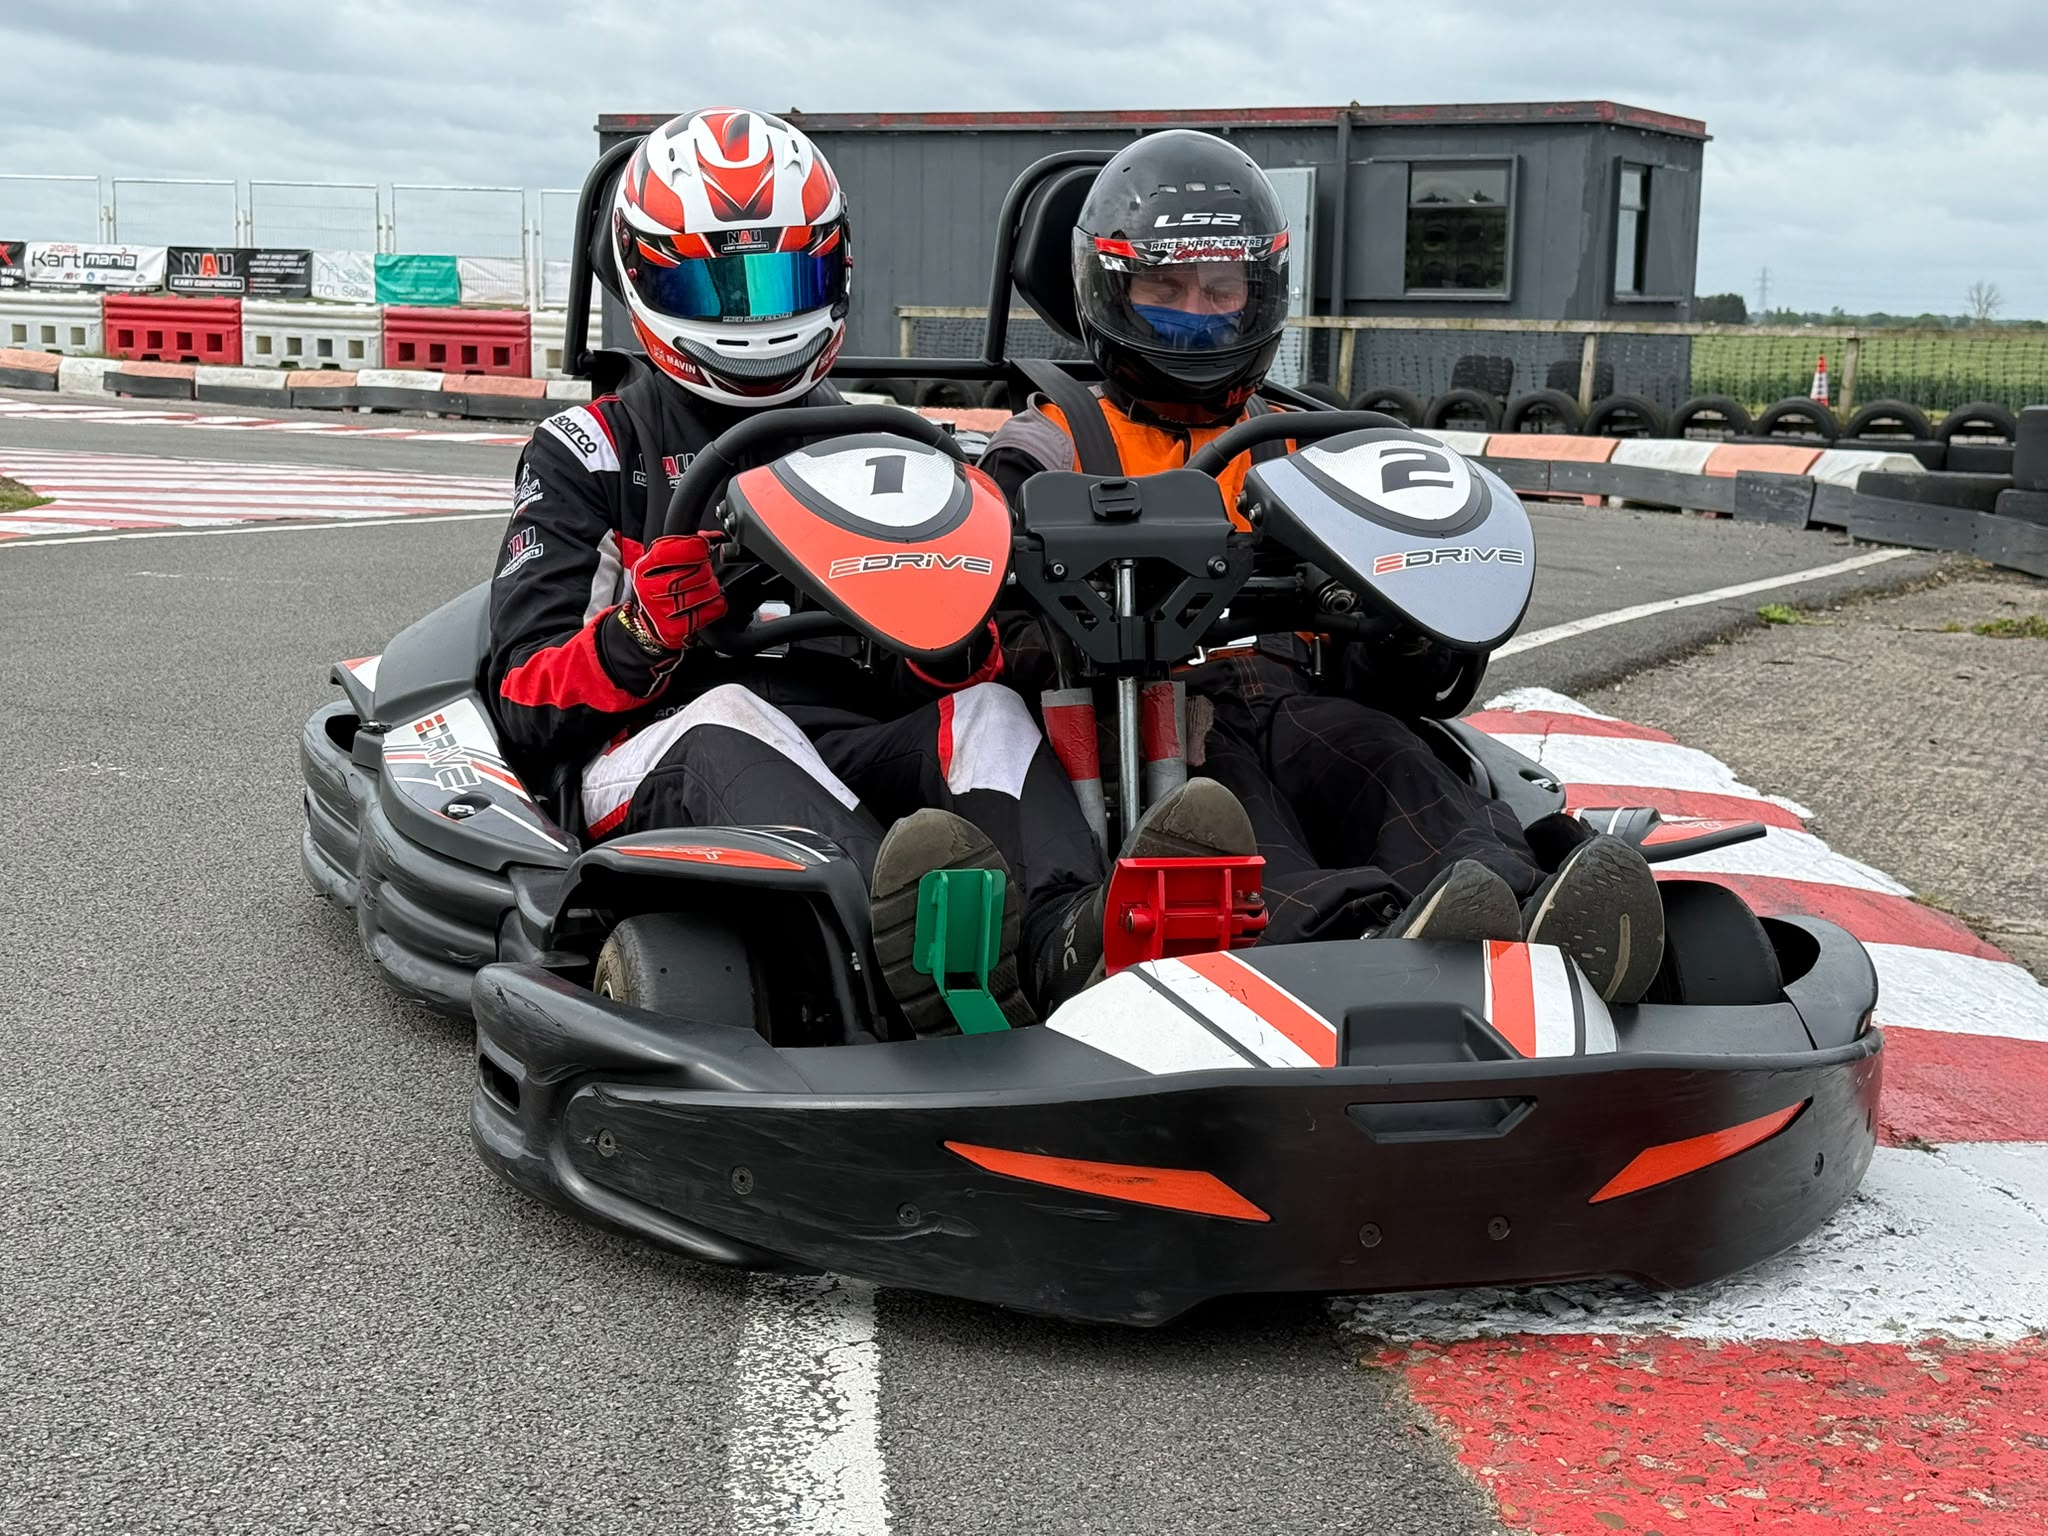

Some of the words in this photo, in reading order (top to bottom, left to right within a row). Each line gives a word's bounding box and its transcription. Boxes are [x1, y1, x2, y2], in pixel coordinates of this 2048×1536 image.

[1154, 213, 1242, 228] LS2
[727, 229, 762, 245] NAU
[49, 245, 78, 253] 2025
[1151, 242, 1185, 252] RACE
[1187, 240, 1217, 250] KART
[1222, 239, 1262, 248] CENTRE
[32, 251, 82, 268] Kart
[85, 254, 136, 267] mania
[183, 252, 234, 278] NAU
[865, 455, 906, 495] 1
[1379, 448, 1454, 494] 2
